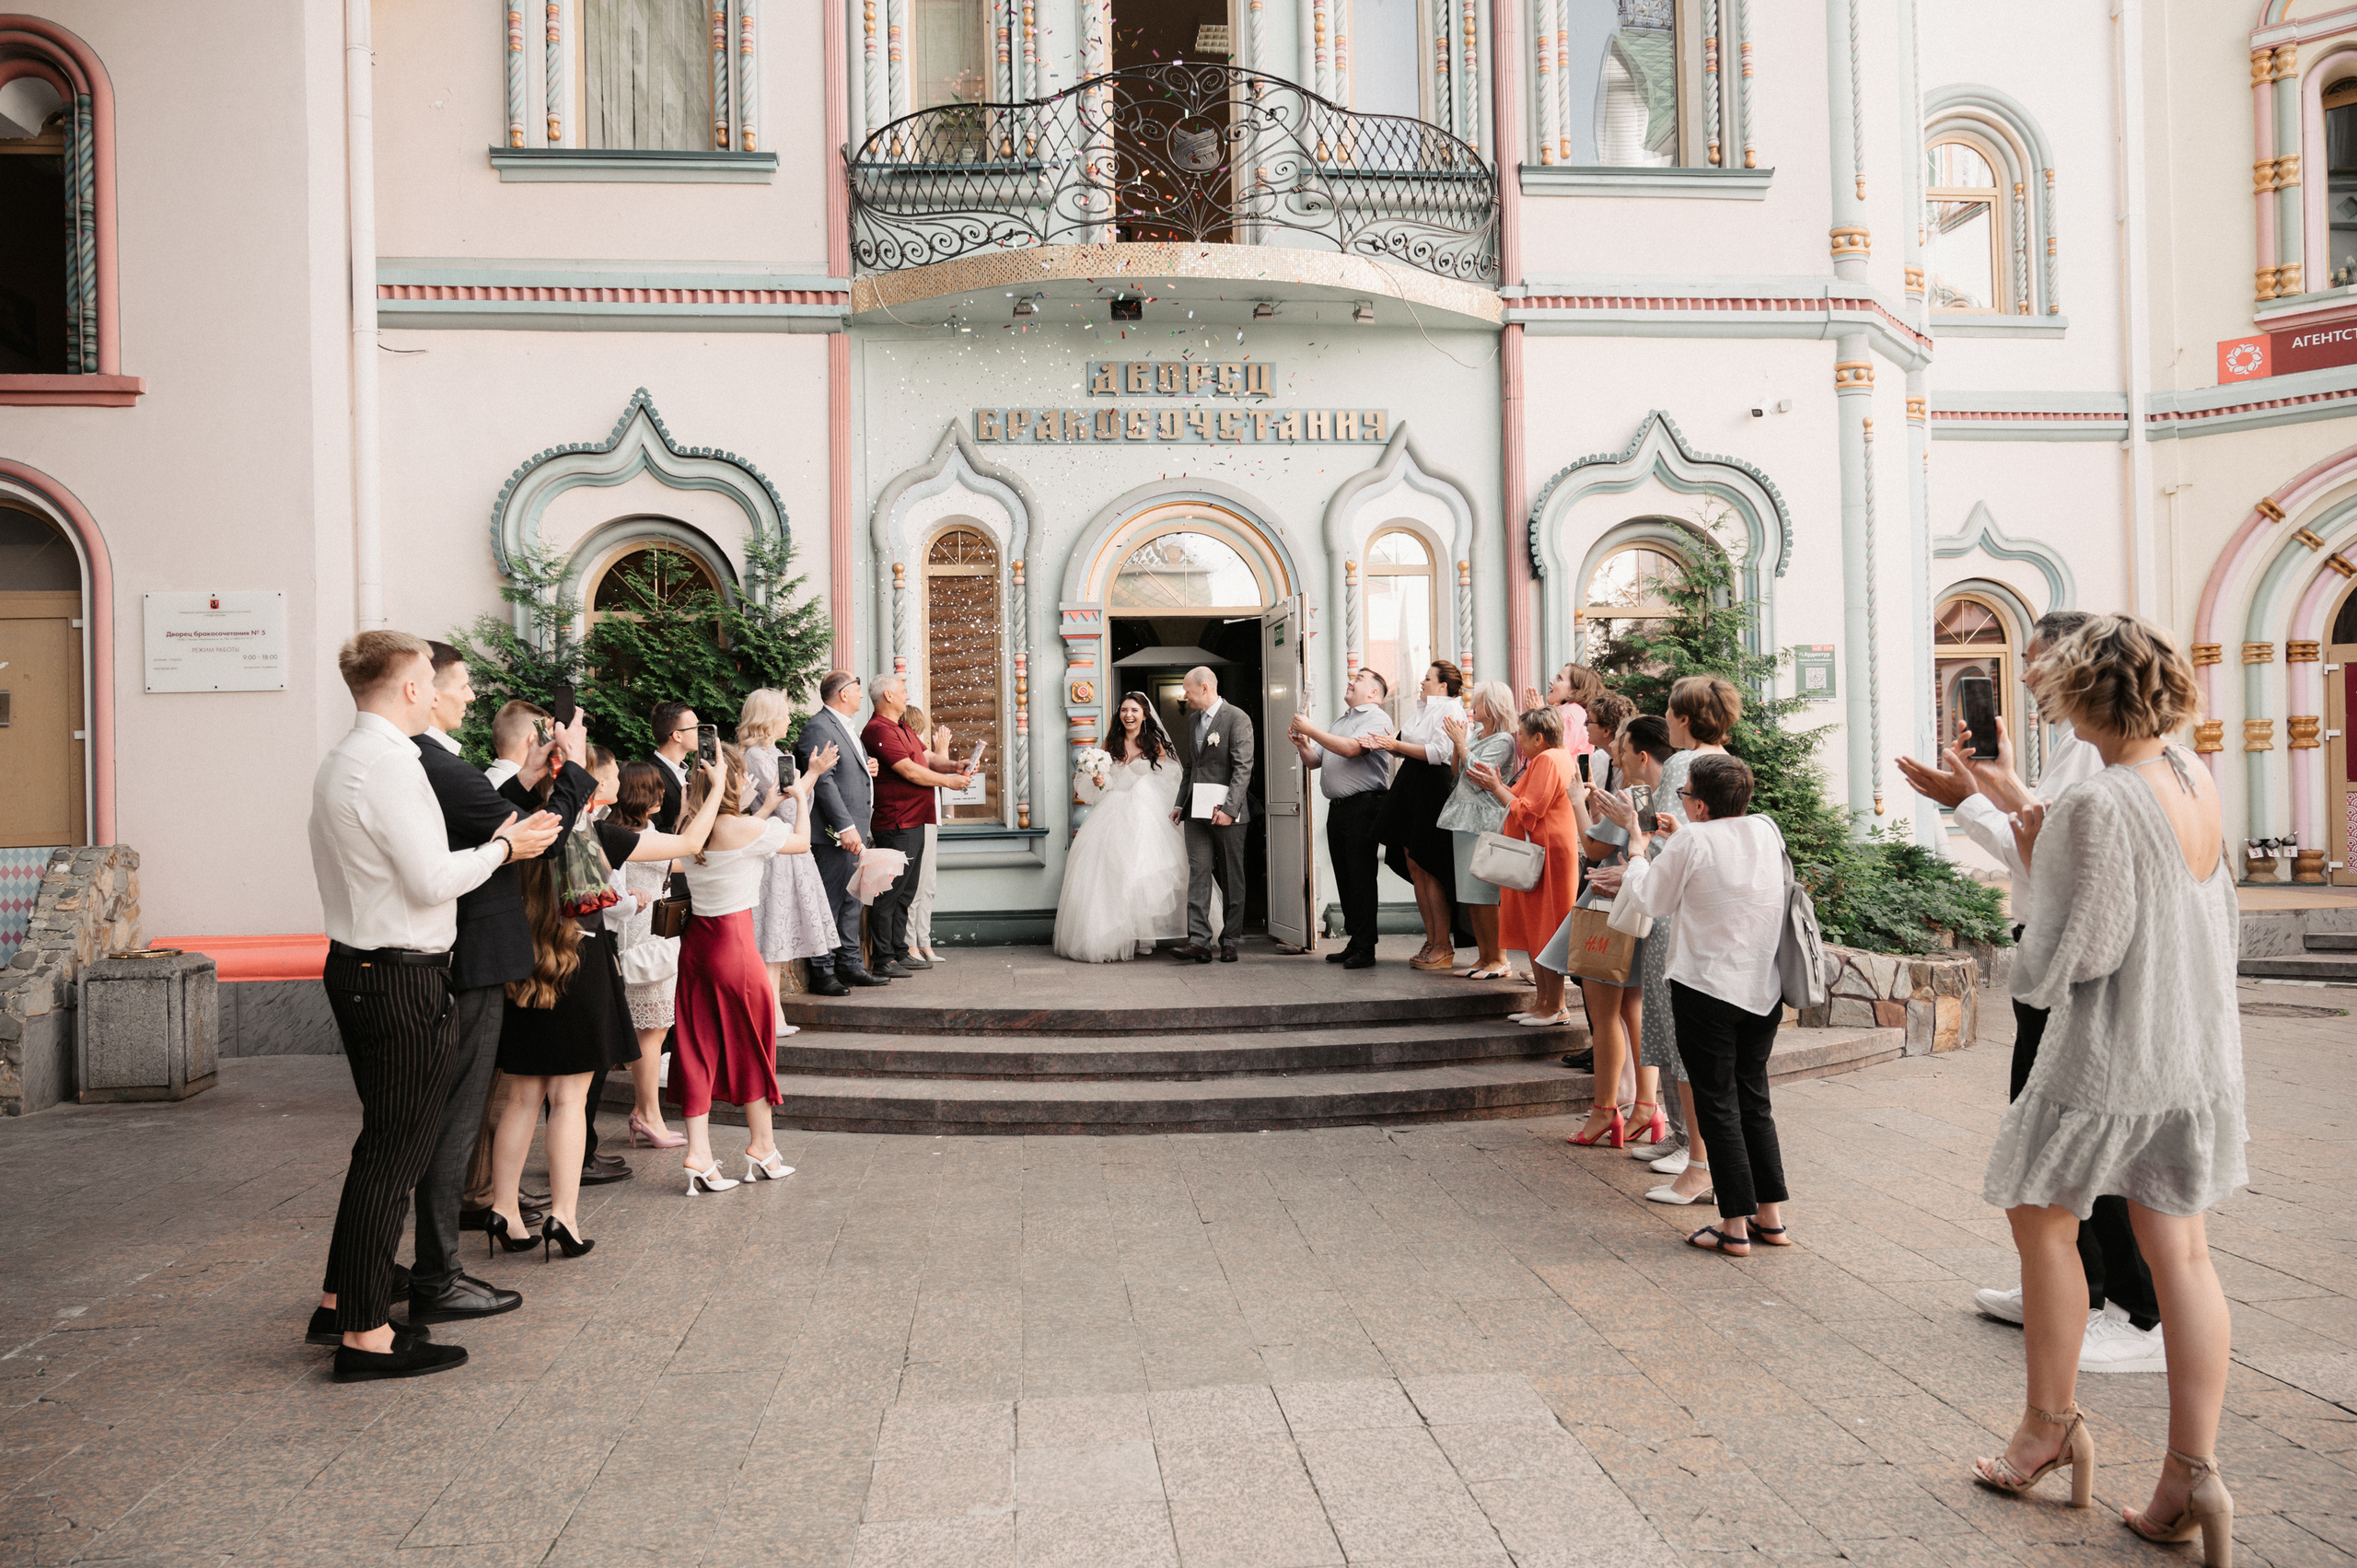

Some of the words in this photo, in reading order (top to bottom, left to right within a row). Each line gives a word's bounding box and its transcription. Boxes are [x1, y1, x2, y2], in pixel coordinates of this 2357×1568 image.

[1092, 362, 1275, 397] ДВОРЕЦ
[977, 409, 1387, 440] БРАКОСОЧЕТАНИЯ
[1584, 935, 1610, 955] H&M
